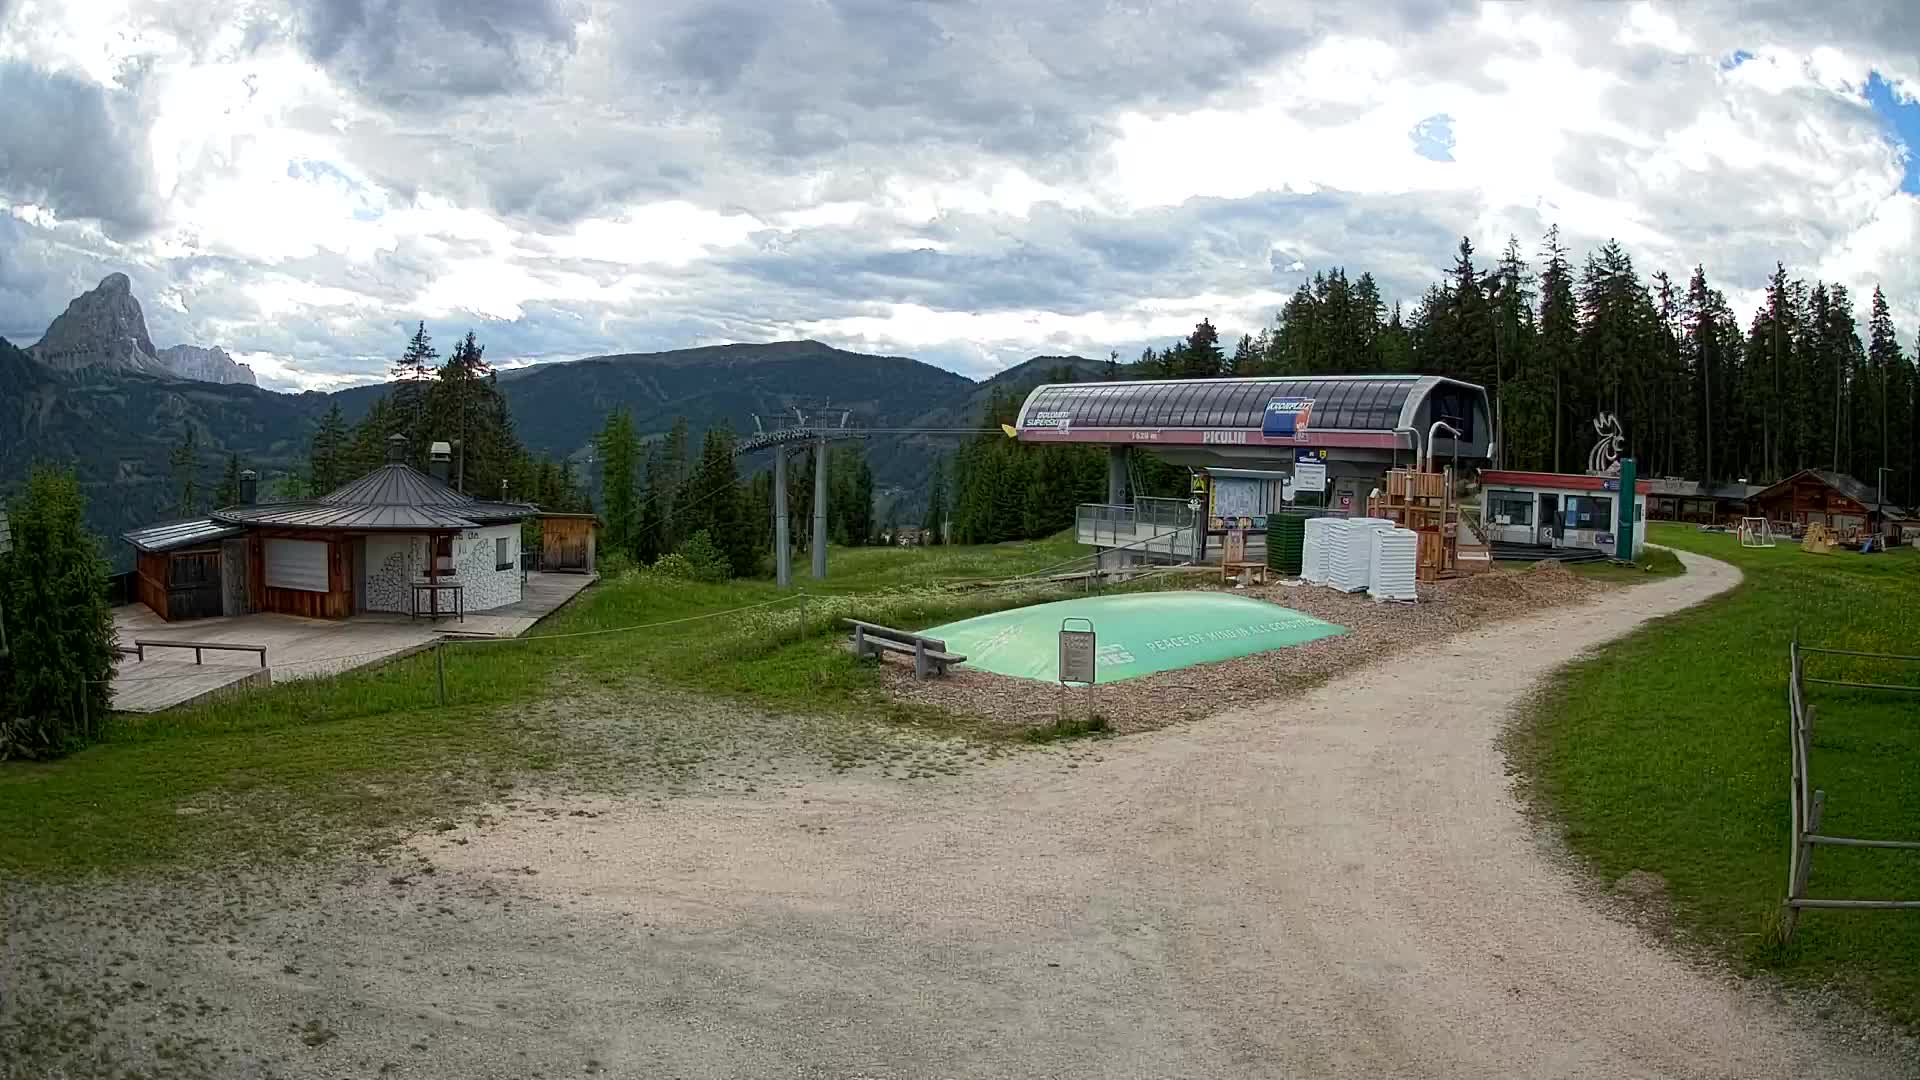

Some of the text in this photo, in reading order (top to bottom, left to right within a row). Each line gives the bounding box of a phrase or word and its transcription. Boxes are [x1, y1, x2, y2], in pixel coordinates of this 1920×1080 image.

[1203, 431, 1247, 443] PICULIN
[1145, 636, 1190, 651] PEACE
[1189, 632, 1205, 644] OF
